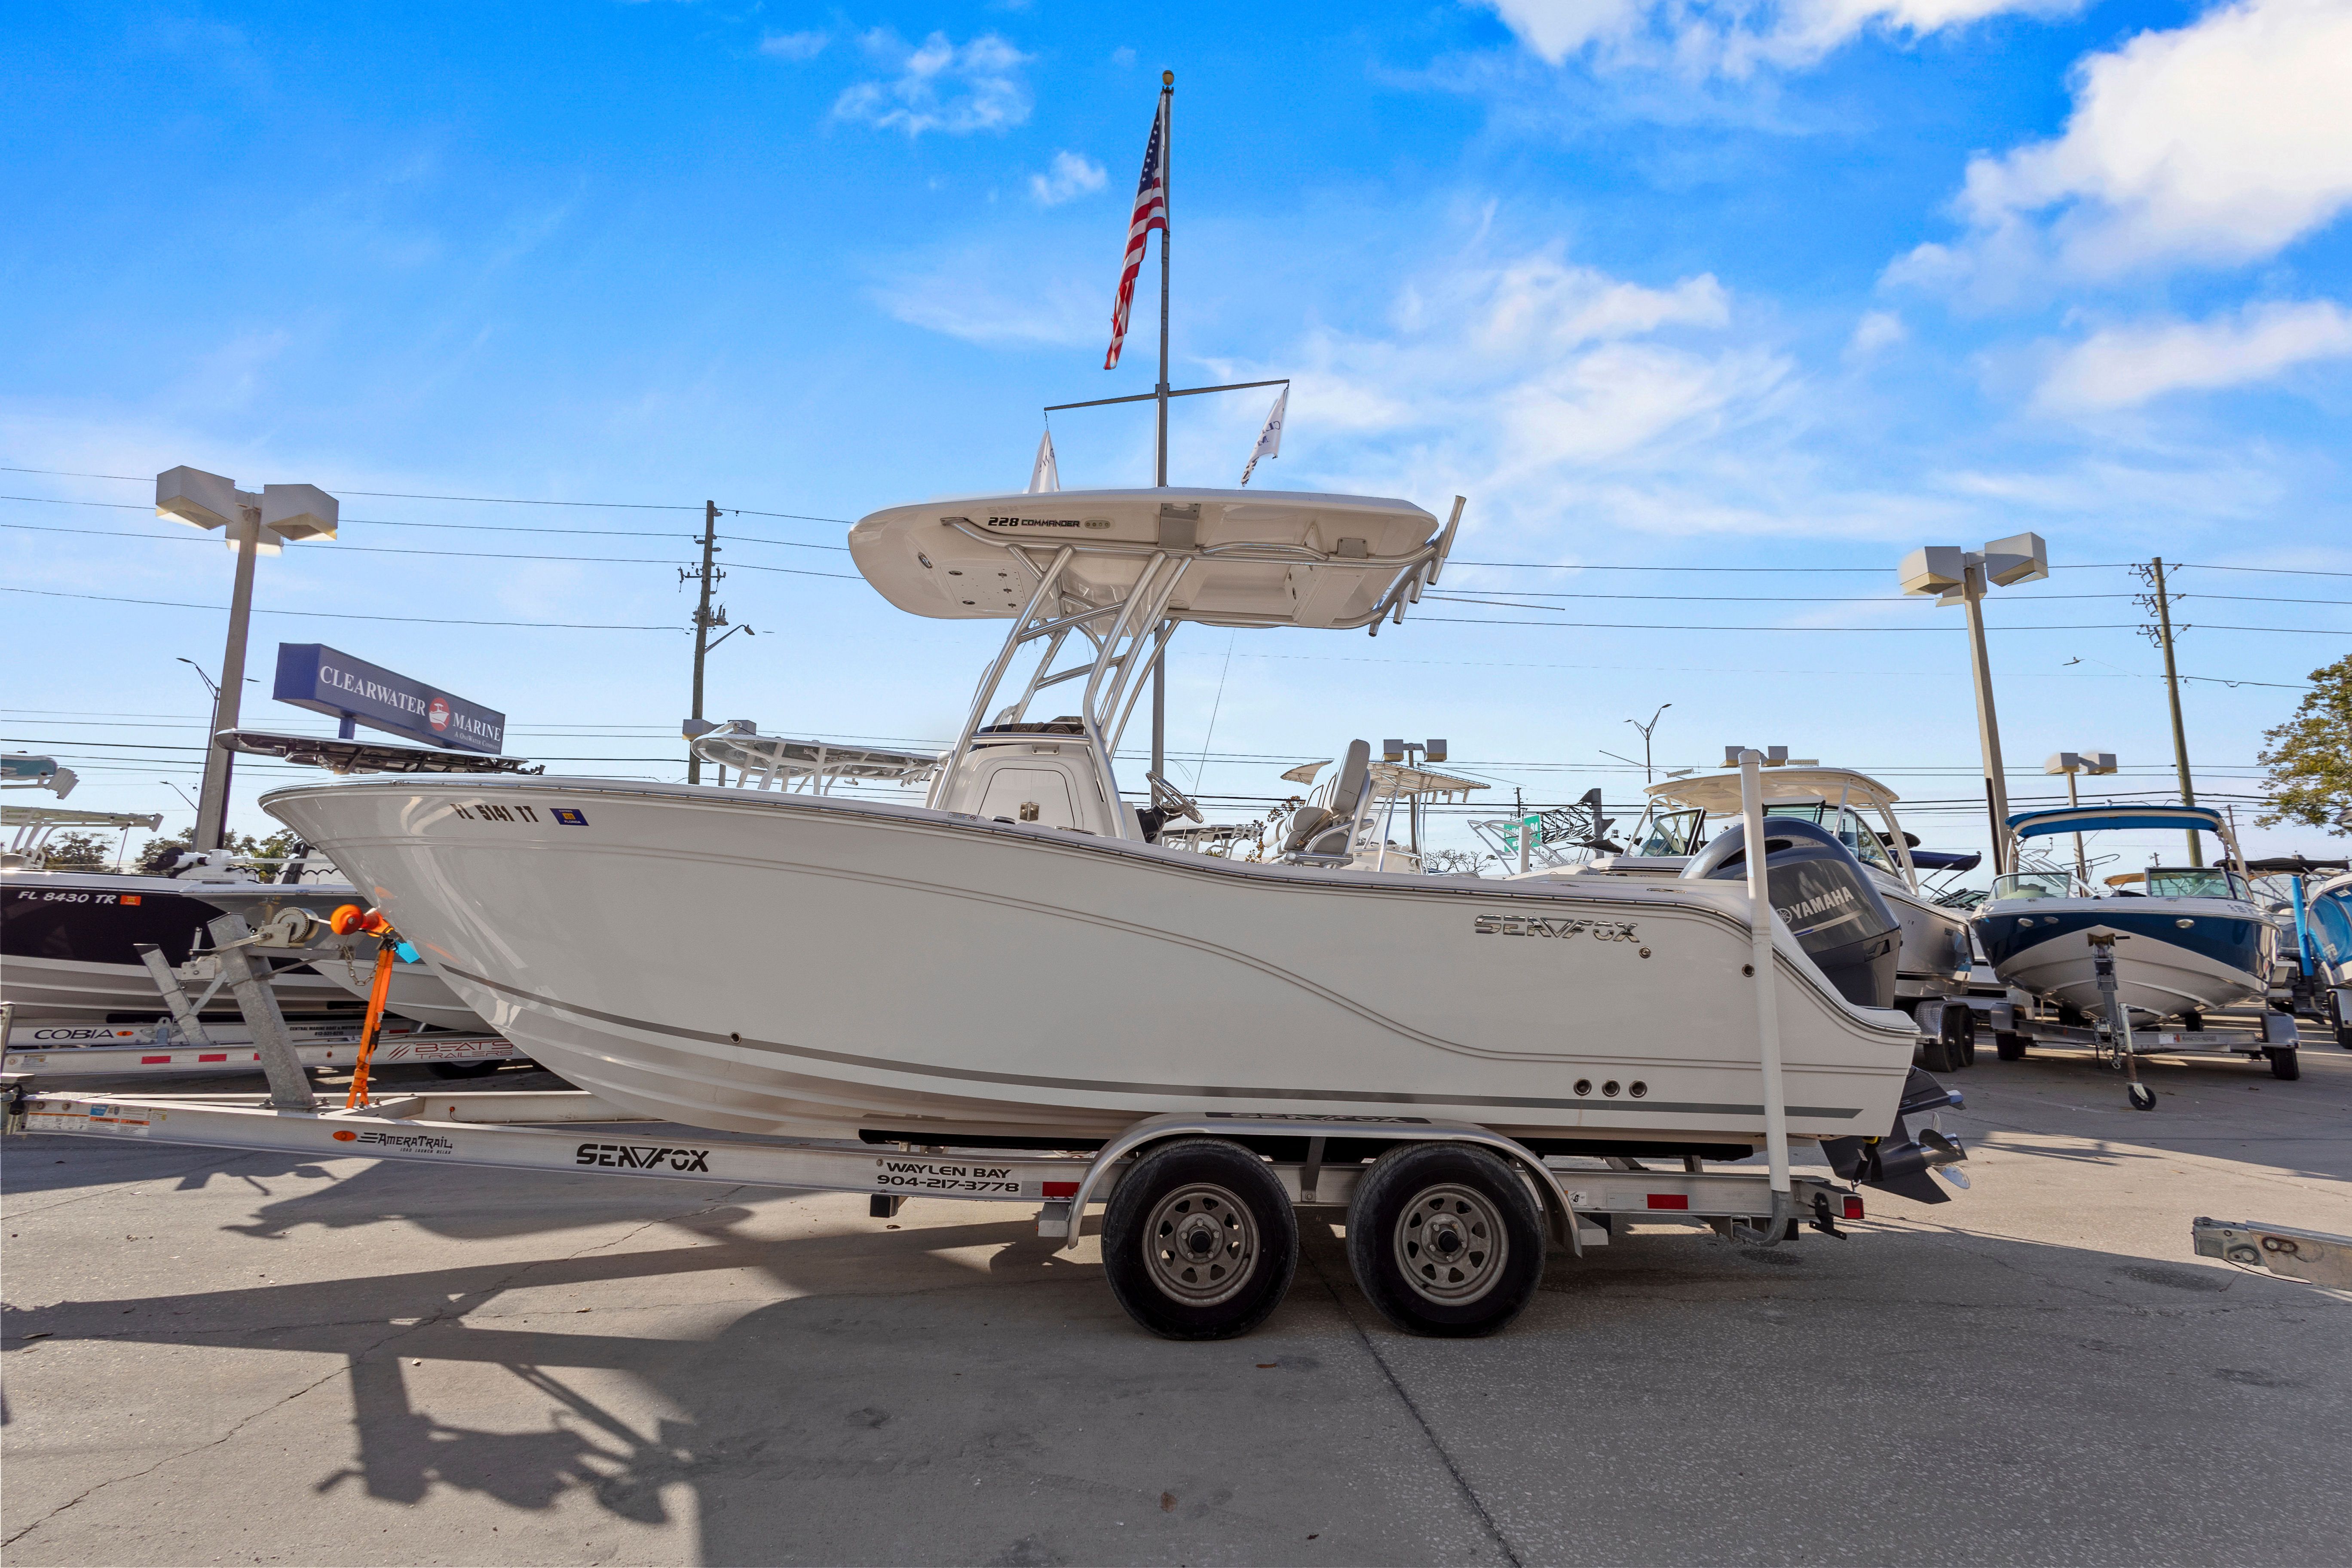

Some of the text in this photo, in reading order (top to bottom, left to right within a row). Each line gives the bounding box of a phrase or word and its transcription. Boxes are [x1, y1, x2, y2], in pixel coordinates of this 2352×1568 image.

[988, 517, 1081, 527] 228 COMMANDER
[320, 666, 501, 741] CLEARWATER MARINE
[449, 803, 539, 822] FL 5141 TT
[18, 891, 117, 904] FL 8430 TR
[1789, 886, 1854, 919] YAMAHA
[34, 1029, 114, 1039] COBIA
[415, 1050, 513, 1059] TRAILERS
[886, 1162, 1012, 1178] WAYLEN BAY
[877, 1175, 1020, 1192] 904-217-3778
